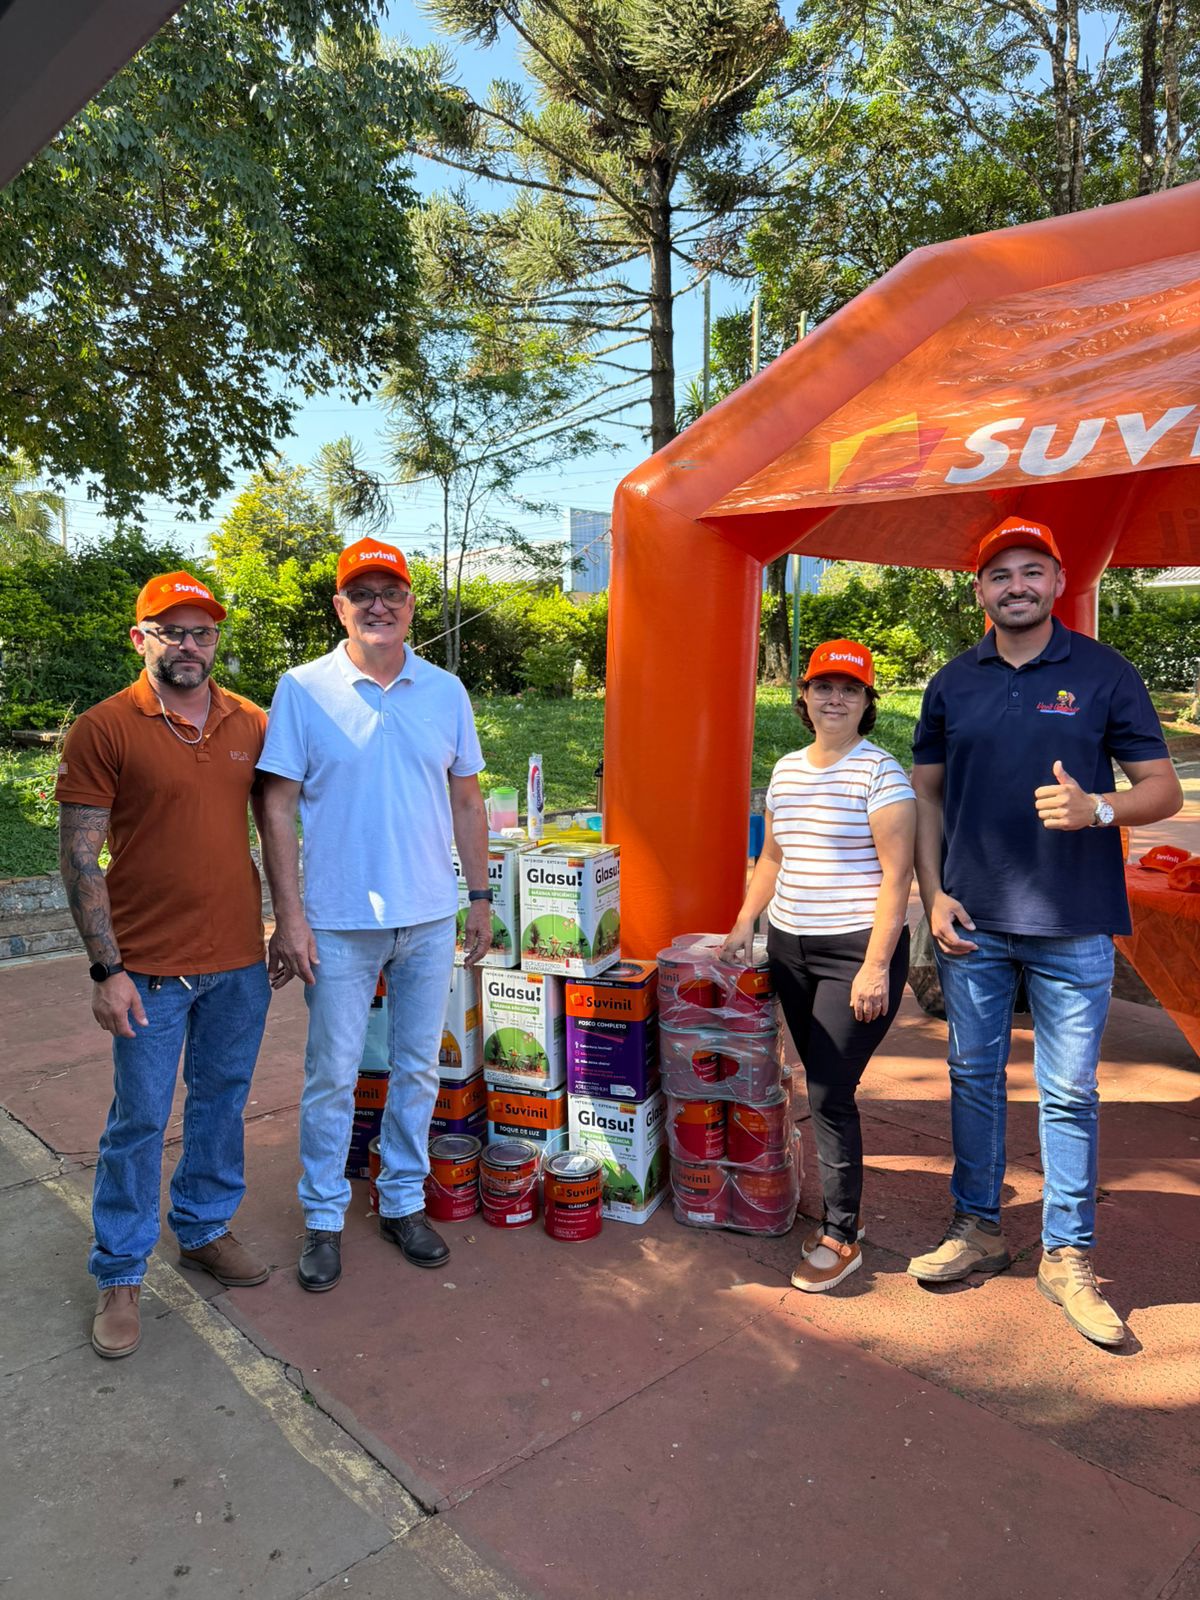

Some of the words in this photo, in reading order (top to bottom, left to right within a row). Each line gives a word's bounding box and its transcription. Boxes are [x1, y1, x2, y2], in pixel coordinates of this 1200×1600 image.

[359, 549, 397, 563] Suvinil
[829, 652, 864, 667] Suvinil
[527, 868, 583, 887] Glasu!
[595, 860, 620, 884] Glasu!
[488, 982, 541, 1001] Glasu!
[586, 996, 632, 1011] Suvinil
[597, 1021, 627, 1029] COMPLETO
[505, 1103, 548, 1119] Suvinil
[578, 1110, 634, 1133] Glasu!
[499, 1125, 519, 1134] TOQUE
